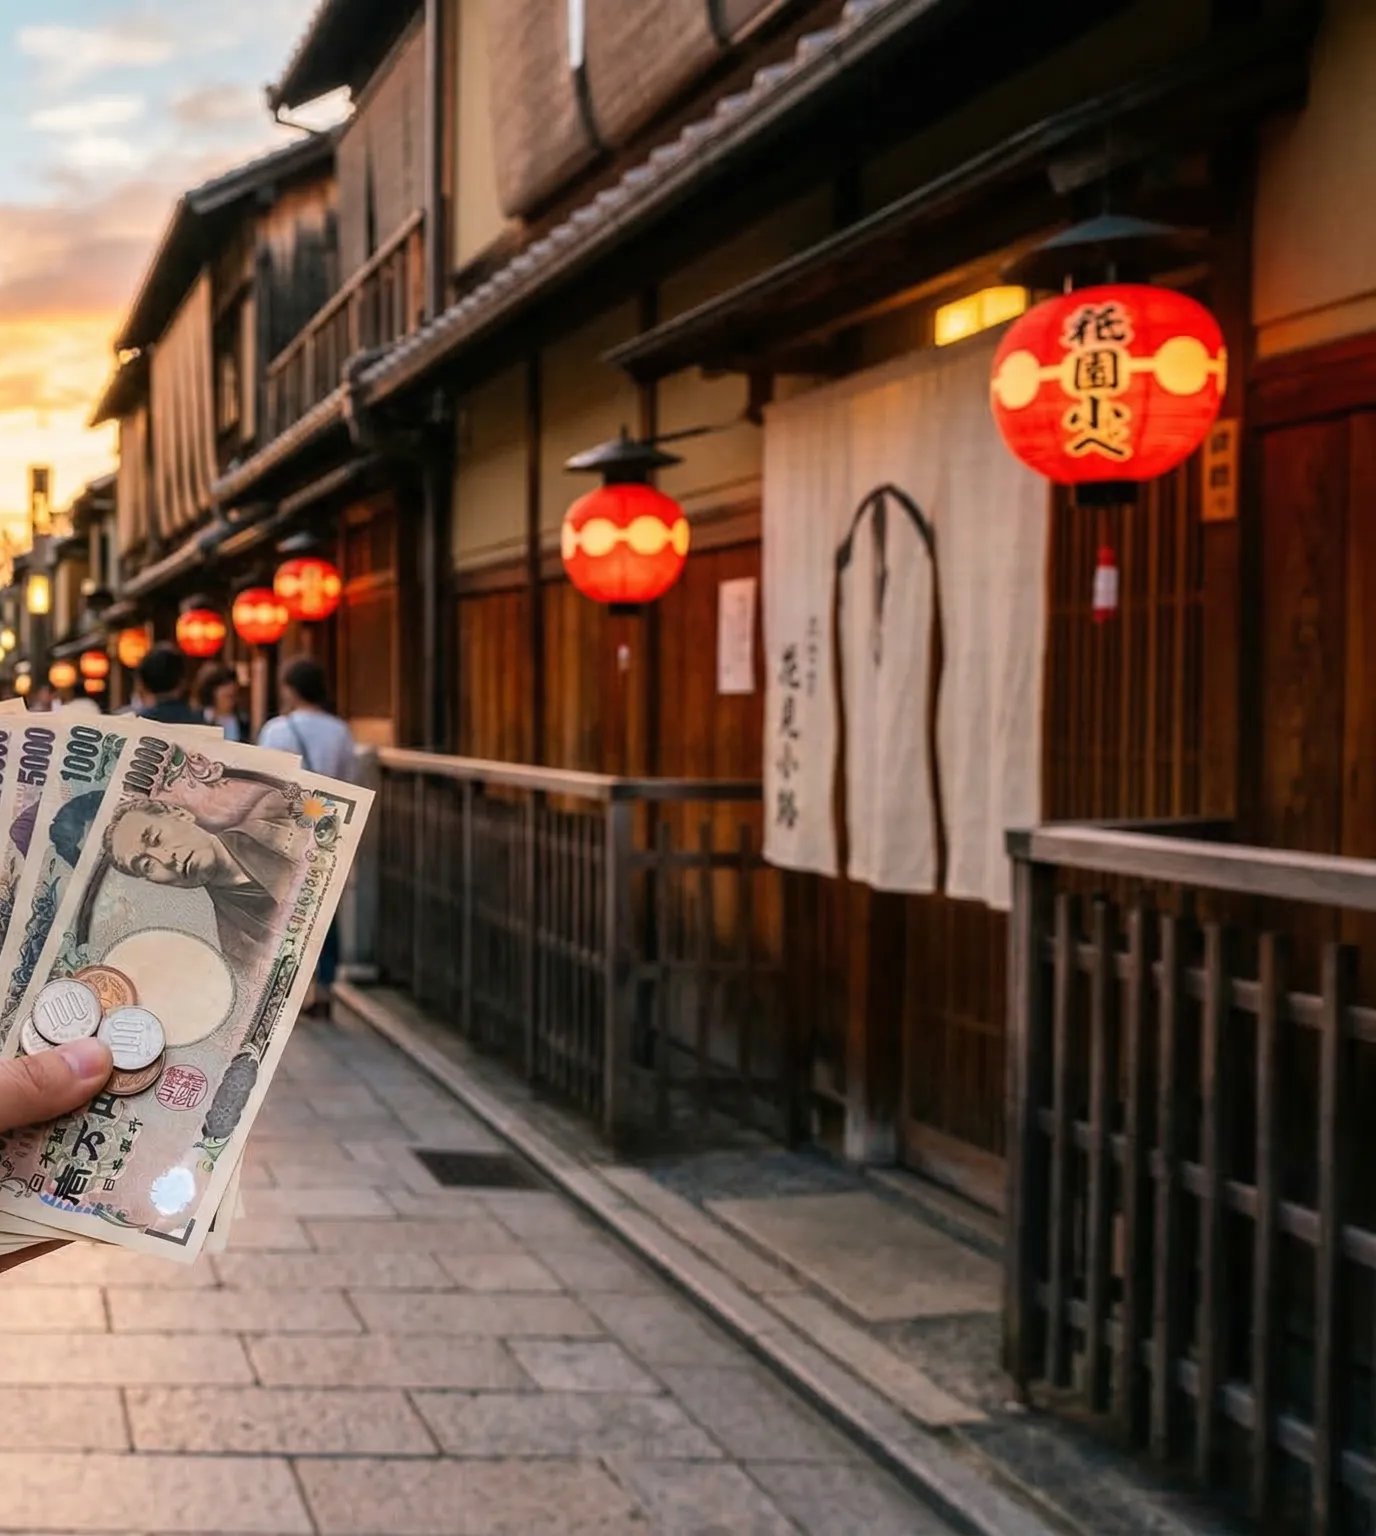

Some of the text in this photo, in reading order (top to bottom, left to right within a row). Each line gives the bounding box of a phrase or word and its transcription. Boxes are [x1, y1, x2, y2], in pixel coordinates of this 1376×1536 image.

[16, 727, 56, 787] 5000
[60, 725, 103, 783] 1000
[122, 736, 170, 798] 10000
[41, 990, 88, 1032] 100
